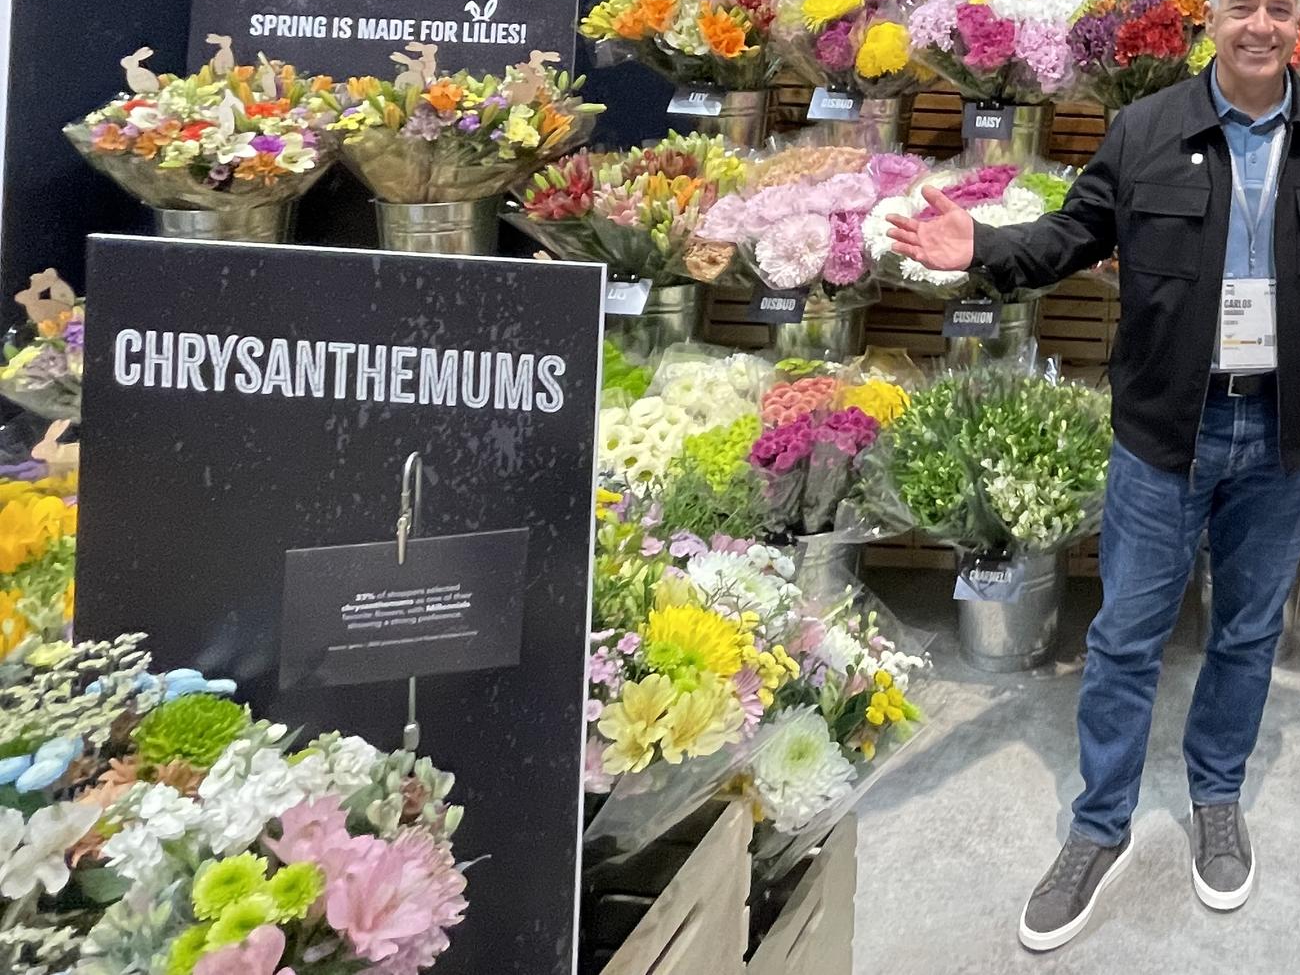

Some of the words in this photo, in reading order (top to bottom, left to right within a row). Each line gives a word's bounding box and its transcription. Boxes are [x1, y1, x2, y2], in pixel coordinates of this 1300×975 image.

[249, 14, 327, 39] SPRING
[332, 16, 352, 39] IS
[357, 18, 415, 41] MADE
[421, 20, 457, 43] FOR
[462, 20, 527, 45] LILIES!
[976, 116, 1002, 128] DAISY
[760, 296, 796, 311] DISBUD
[953, 311, 993, 324] CUSHION
[114, 328, 567, 413] CHRYSANTHEMUMS
